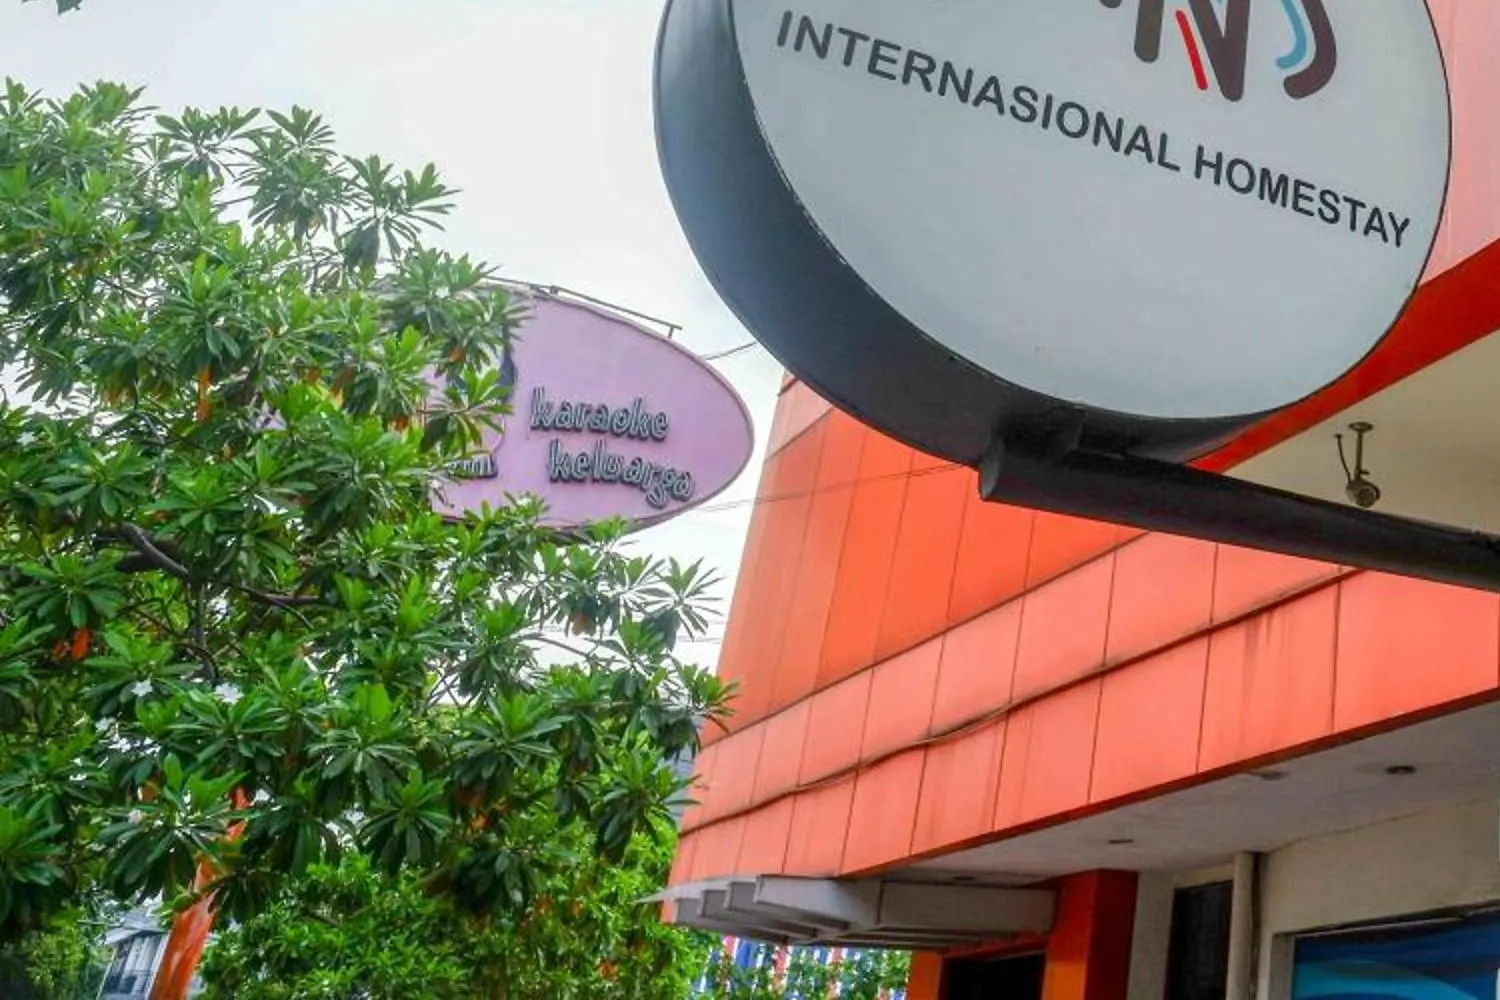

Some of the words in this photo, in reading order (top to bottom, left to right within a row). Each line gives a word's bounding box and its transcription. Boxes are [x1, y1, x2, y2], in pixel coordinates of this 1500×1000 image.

[776, 10, 1181, 171] INTERNASIONAL
[1194, 145, 1411, 249] HOMESTAY
[530, 387, 671, 441] karaoke
[546, 440, 694, 509] keluarga
